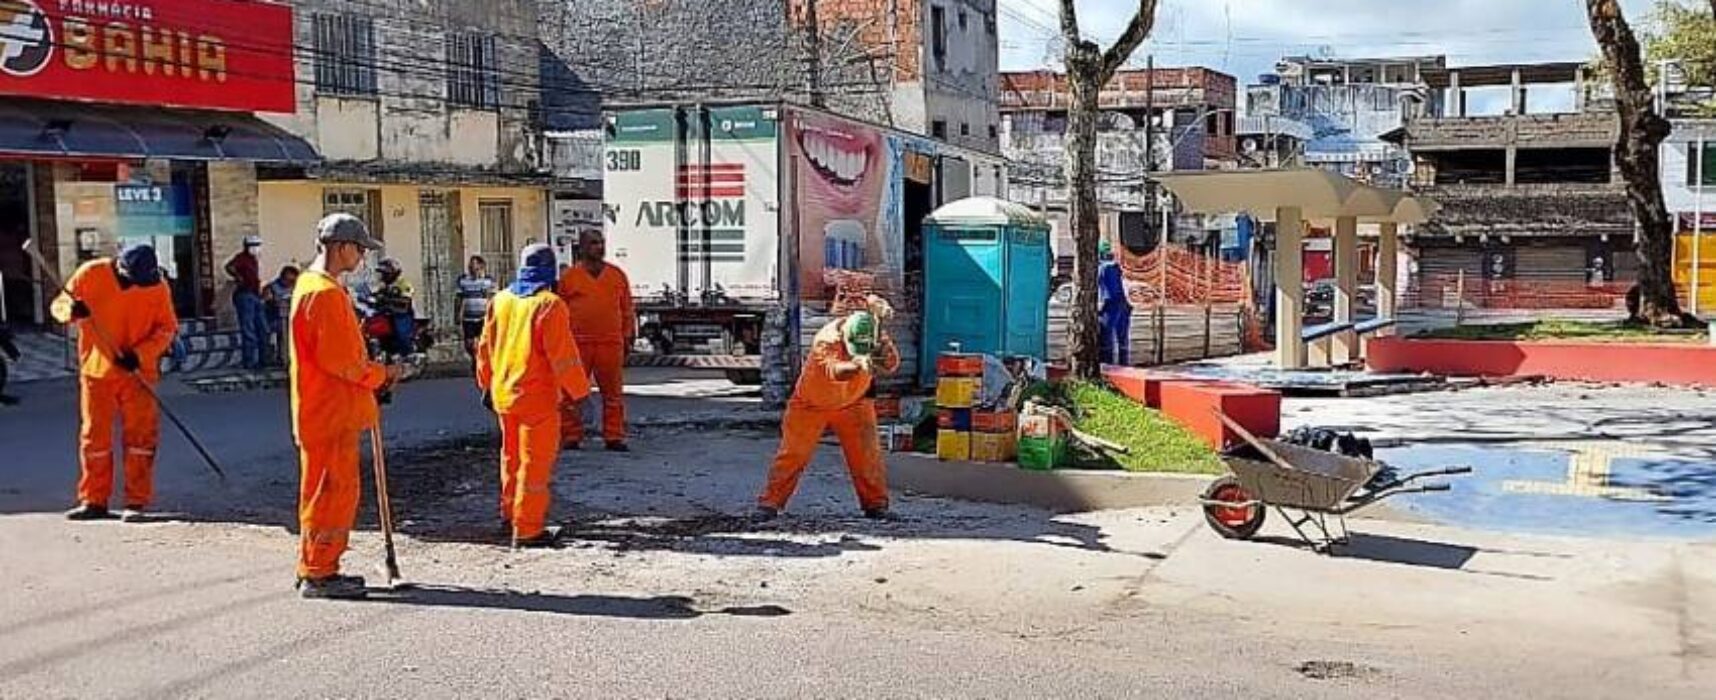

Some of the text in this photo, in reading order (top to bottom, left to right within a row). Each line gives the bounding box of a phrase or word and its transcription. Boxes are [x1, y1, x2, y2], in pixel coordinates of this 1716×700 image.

[63, 15, 227, 82] BAHIA
[606, 149, 641, 171] 390
[118, 186, 163, 201] LEVE 3
[635, 199, 745, 227] ARCOM
